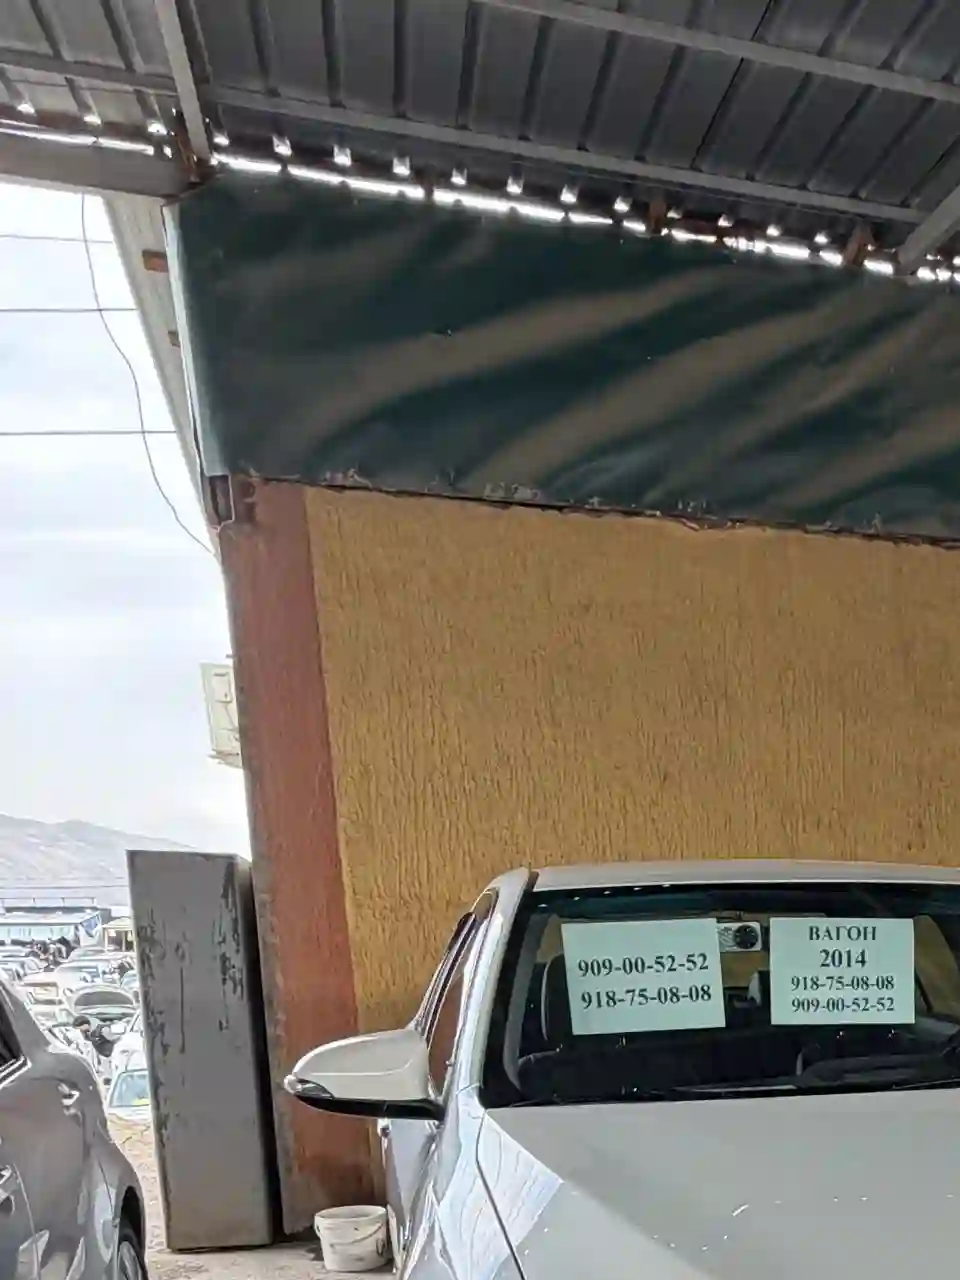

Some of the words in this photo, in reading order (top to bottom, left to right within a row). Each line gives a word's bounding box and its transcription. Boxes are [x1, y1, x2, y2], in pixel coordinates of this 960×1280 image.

[809, 925, 877, 941] ВАГОН
[577, 952, 709, 978] 909-00-52-52
[819, 949, 867, 968] 2014
[791, 975, 895, 991] 918-75-08-08
[581, 984, 712, 1010] 918-75-08-08
[791, 997, 895, 1012] 909-00-52-52
